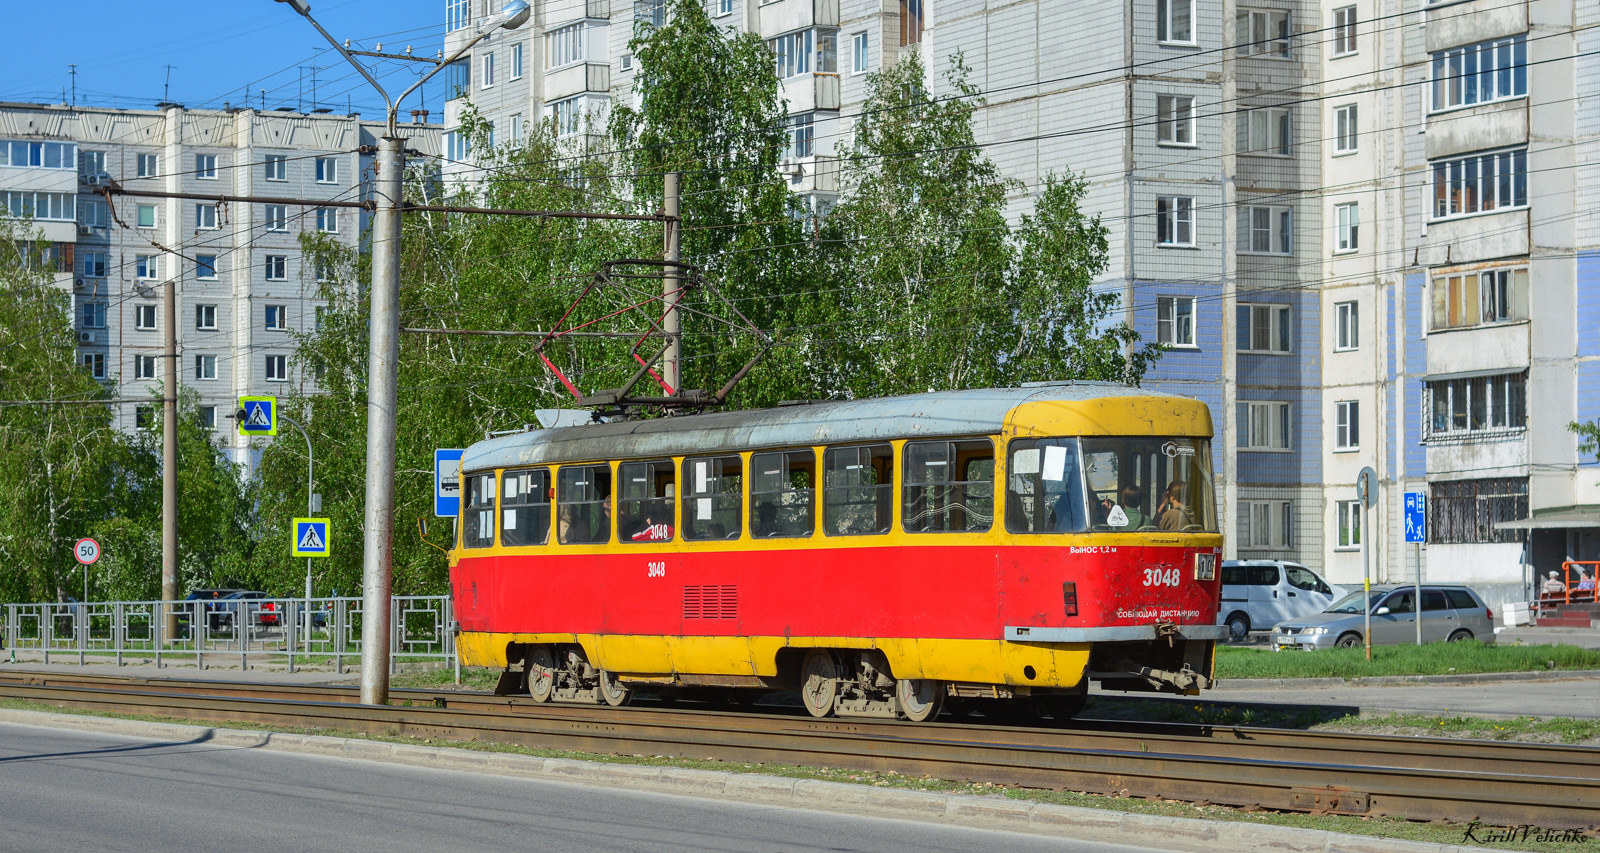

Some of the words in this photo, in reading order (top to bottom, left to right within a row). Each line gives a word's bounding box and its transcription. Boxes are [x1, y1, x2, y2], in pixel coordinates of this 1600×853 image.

[650, 524, 668, 539] 3048
[80, 546, 94, 556] 50
[1099, 546, 1110, 554] 1,2
[648, 561, 665, 577] 3048
[1143, 568, 1180, 587] 3048
[1160, 609, 1200, 618] ДИСТАНЦИЮ
